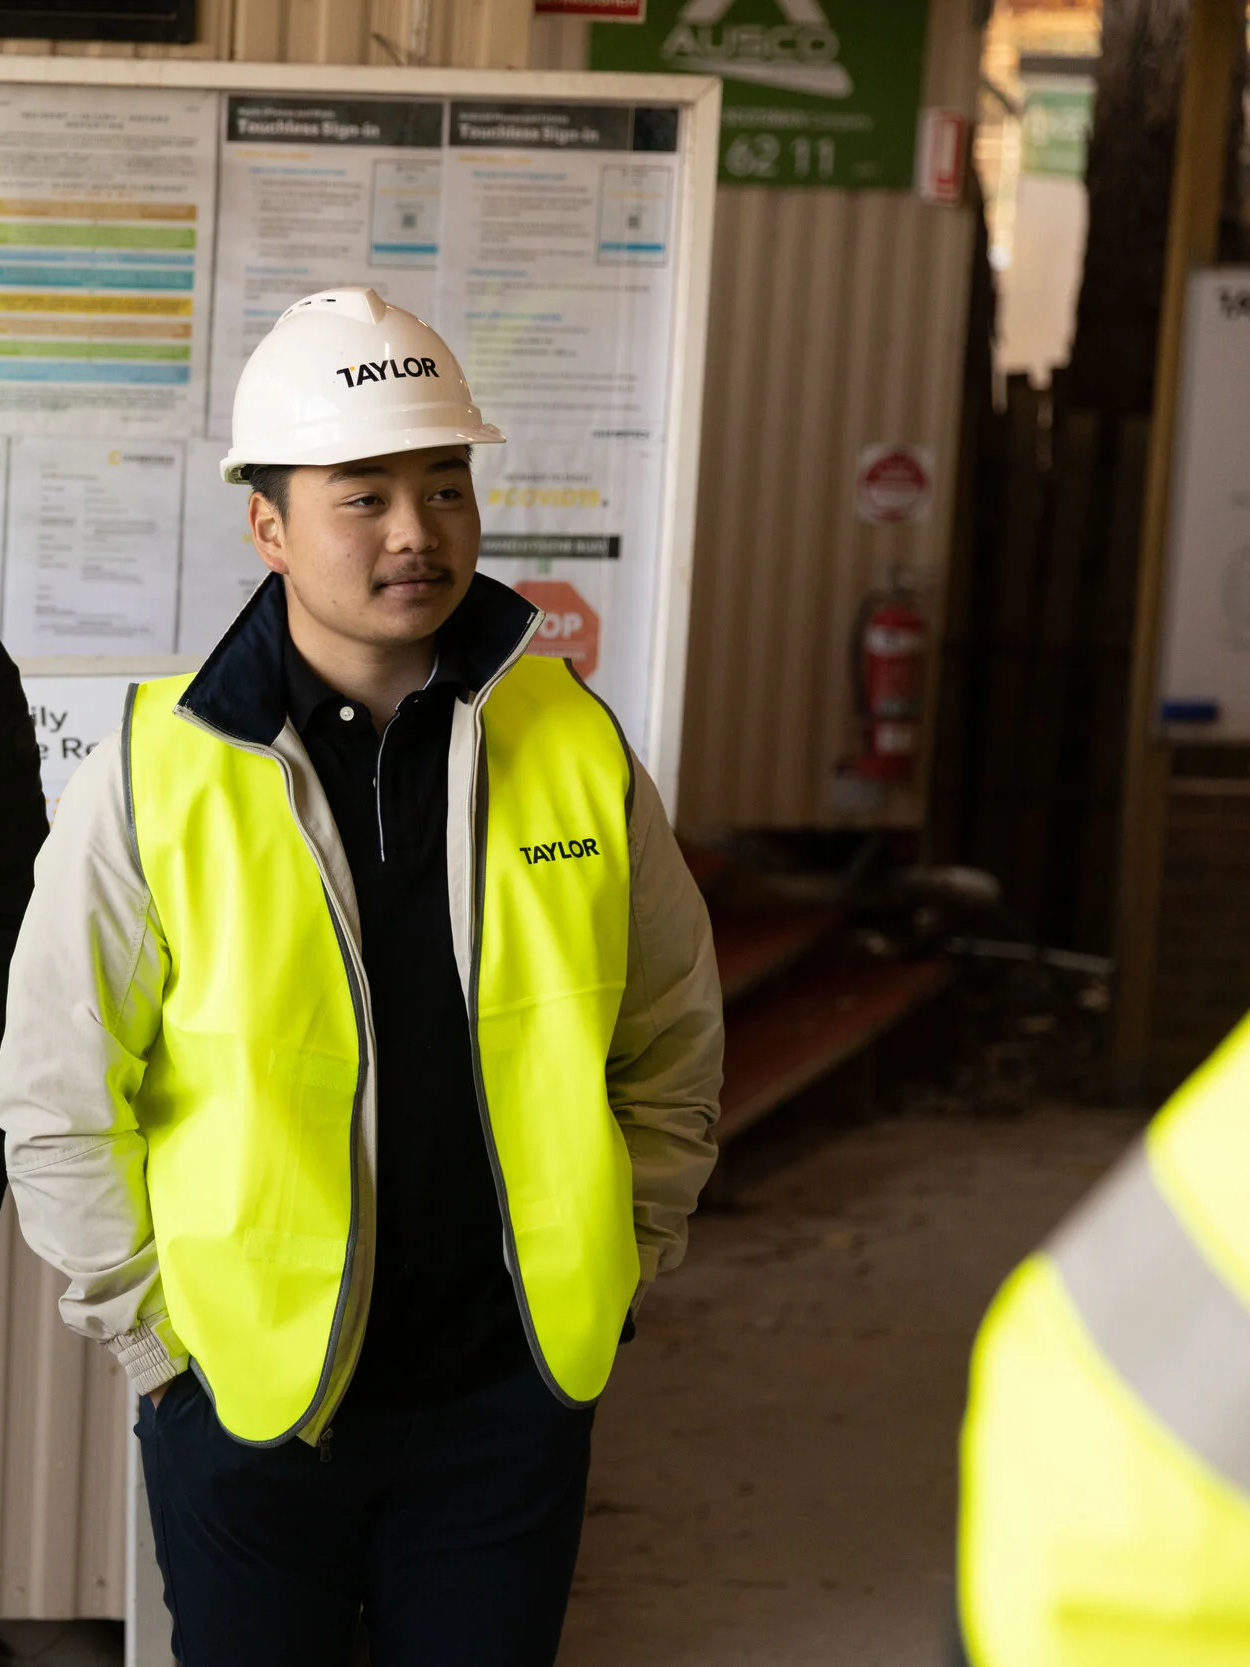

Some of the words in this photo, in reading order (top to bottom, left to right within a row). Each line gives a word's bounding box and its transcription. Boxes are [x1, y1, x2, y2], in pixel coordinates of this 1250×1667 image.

[661, 25, 841, 63] AUSCO
[725, 133, 781, 177] 62
[336, 357, 440, 388] TAYLOR
[519, 838, 601, 865] TAYLOR
